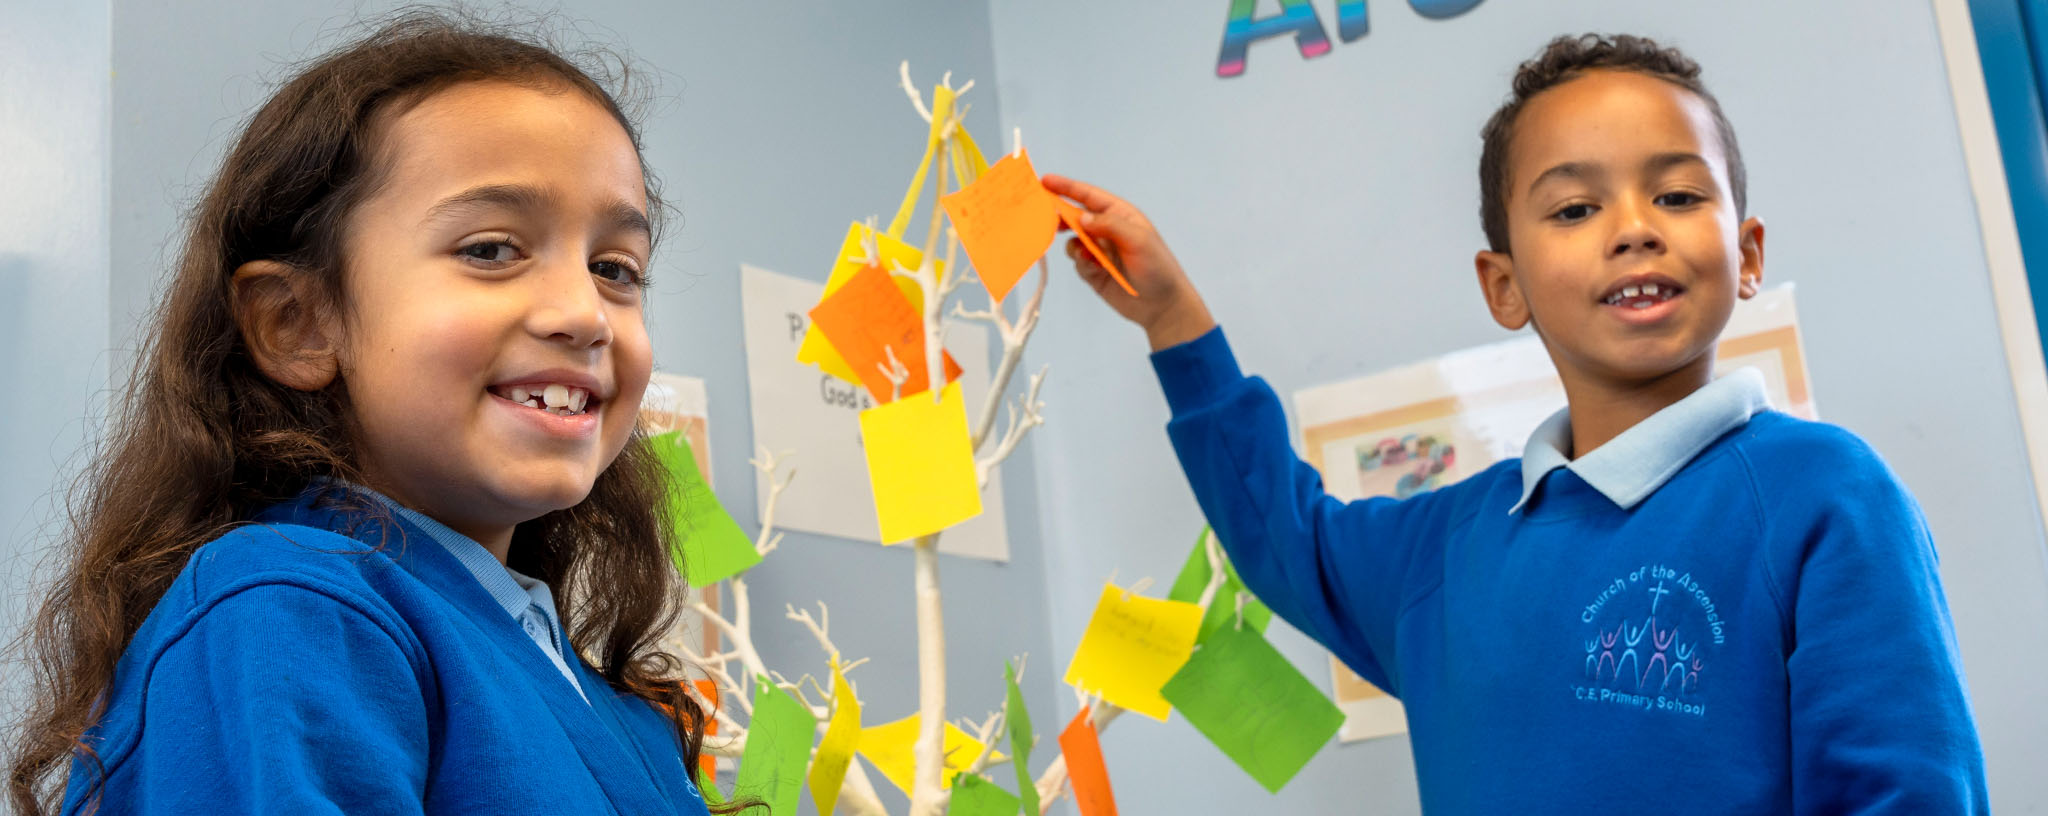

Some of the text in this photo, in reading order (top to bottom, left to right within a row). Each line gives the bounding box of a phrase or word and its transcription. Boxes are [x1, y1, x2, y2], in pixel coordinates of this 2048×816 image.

[1582, 564, 1725, 644] Church of the Ascension
[1601, 688, 1653, 710] Primary
[1657, 695, 1705, 716] School
